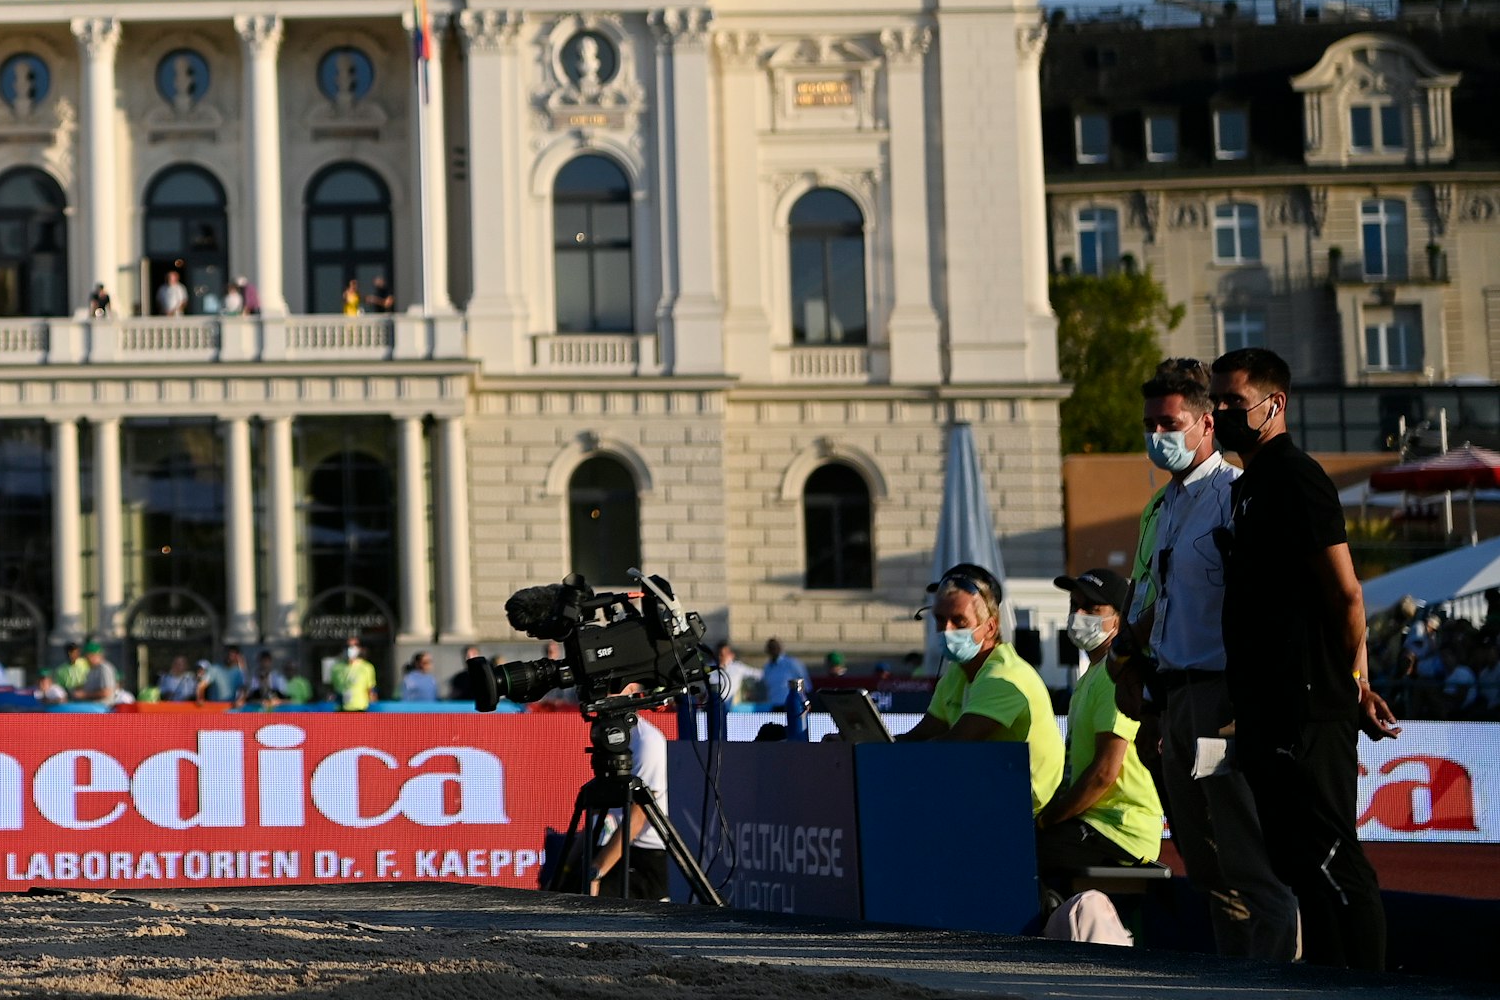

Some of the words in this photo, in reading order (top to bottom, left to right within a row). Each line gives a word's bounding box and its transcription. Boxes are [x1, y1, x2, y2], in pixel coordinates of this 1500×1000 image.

[597, 646, 614, 658] SRF
[6, 849, 300, 881] LABORATORIEN
[314, 849, 364, 879] Dr.
[376, 848, 402, 878] F.
[415, 848, 546, 879] KAEPP
[720, 822, 844, 878] WELTKLASSE
